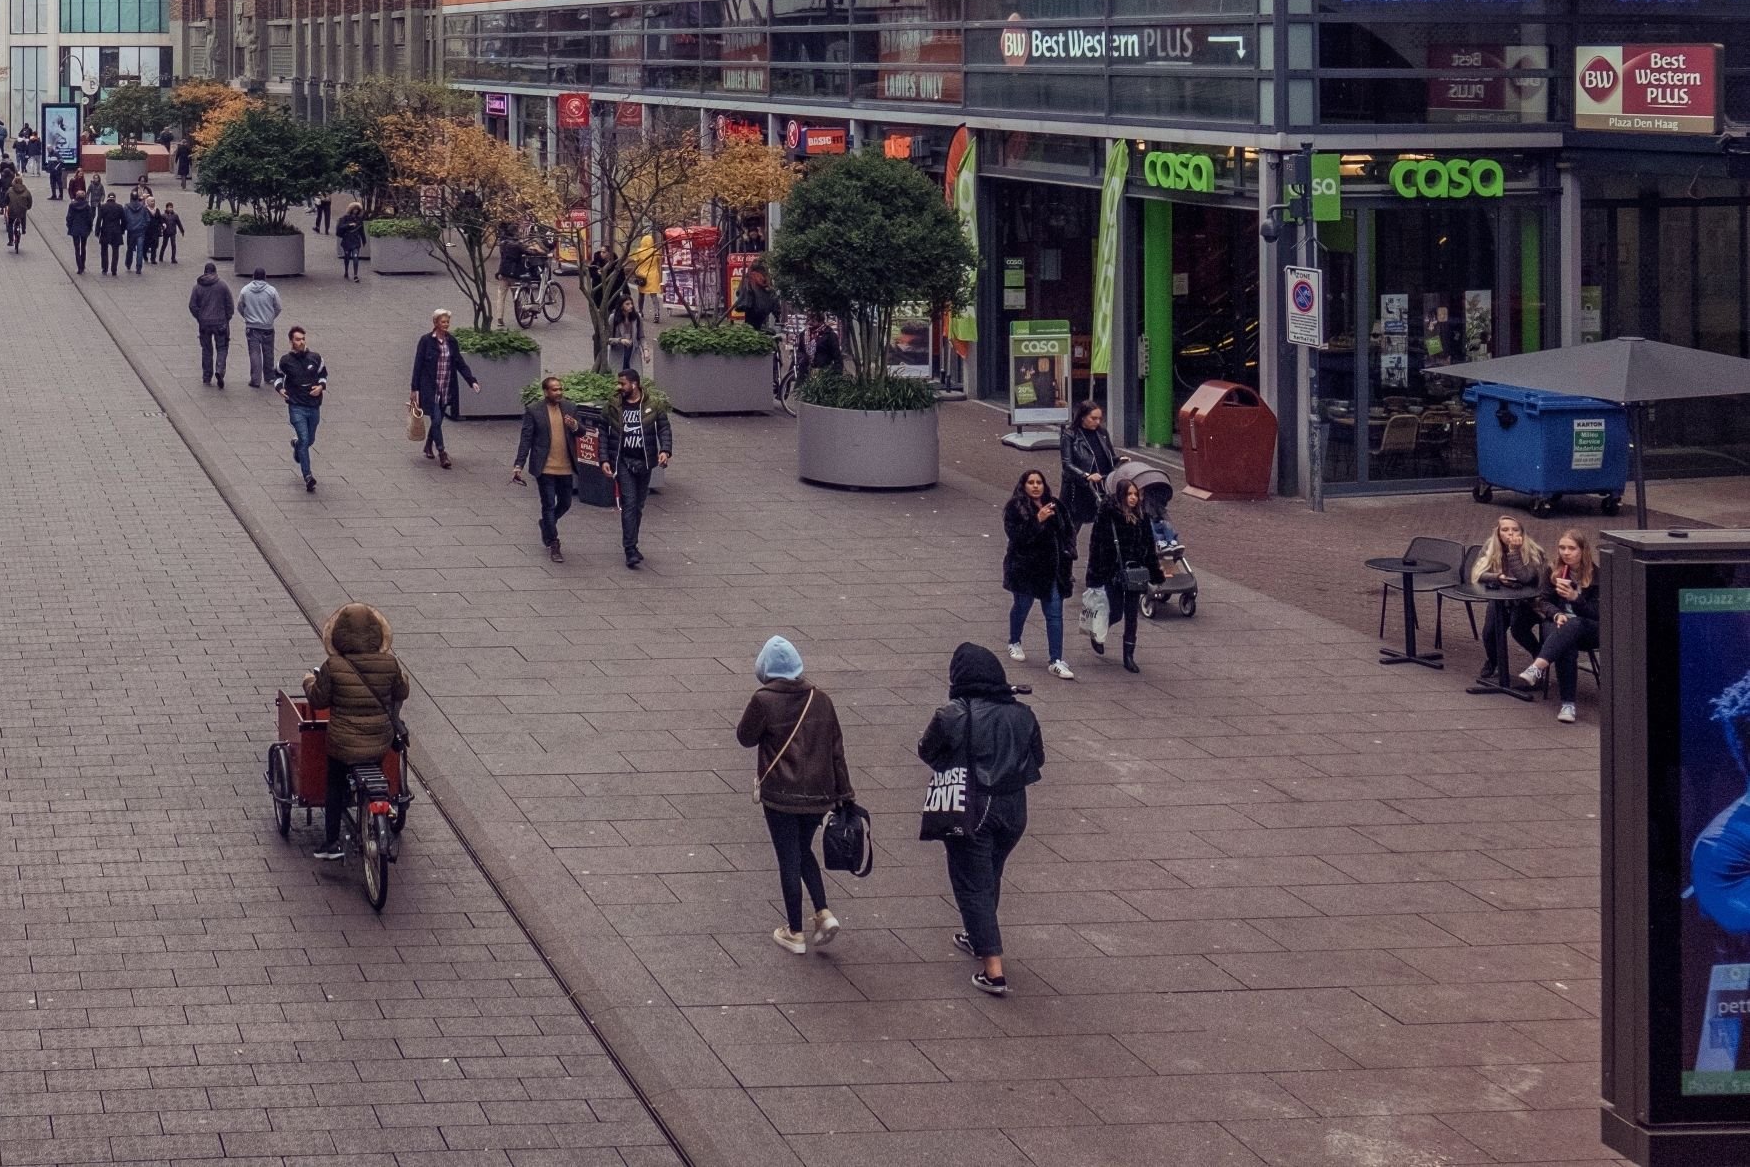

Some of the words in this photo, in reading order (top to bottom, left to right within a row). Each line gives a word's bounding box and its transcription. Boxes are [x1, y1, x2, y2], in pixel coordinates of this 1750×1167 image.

[1003, 32, 1026, 57] BW
[1031, 30, 1066, 57] Best
[1143, 27, 1193, 58] PLUS
[1650, 52, 1686, 69] Best
[723, 69, 746, 90] LADIES
[747, 70, 764, 91] ONLY
[884, 73, 917, 98] LADIES
[919, 72, 944, 99] ONLY
[1584, 72, 1613, 89] BW
[1635, 69, 1701, 86] Western
[1608, 116, 1632, 128] Plaza
[1634, 117, 1652, 128] Den
[1654, 118, 1679, 132] Haag
[1144, 151, 1215, 193] casa
[1388, 158, 1504, 198] casa
[1021, 340, 1059, 353] casa
[923, 784, 967, 812] LOVE
